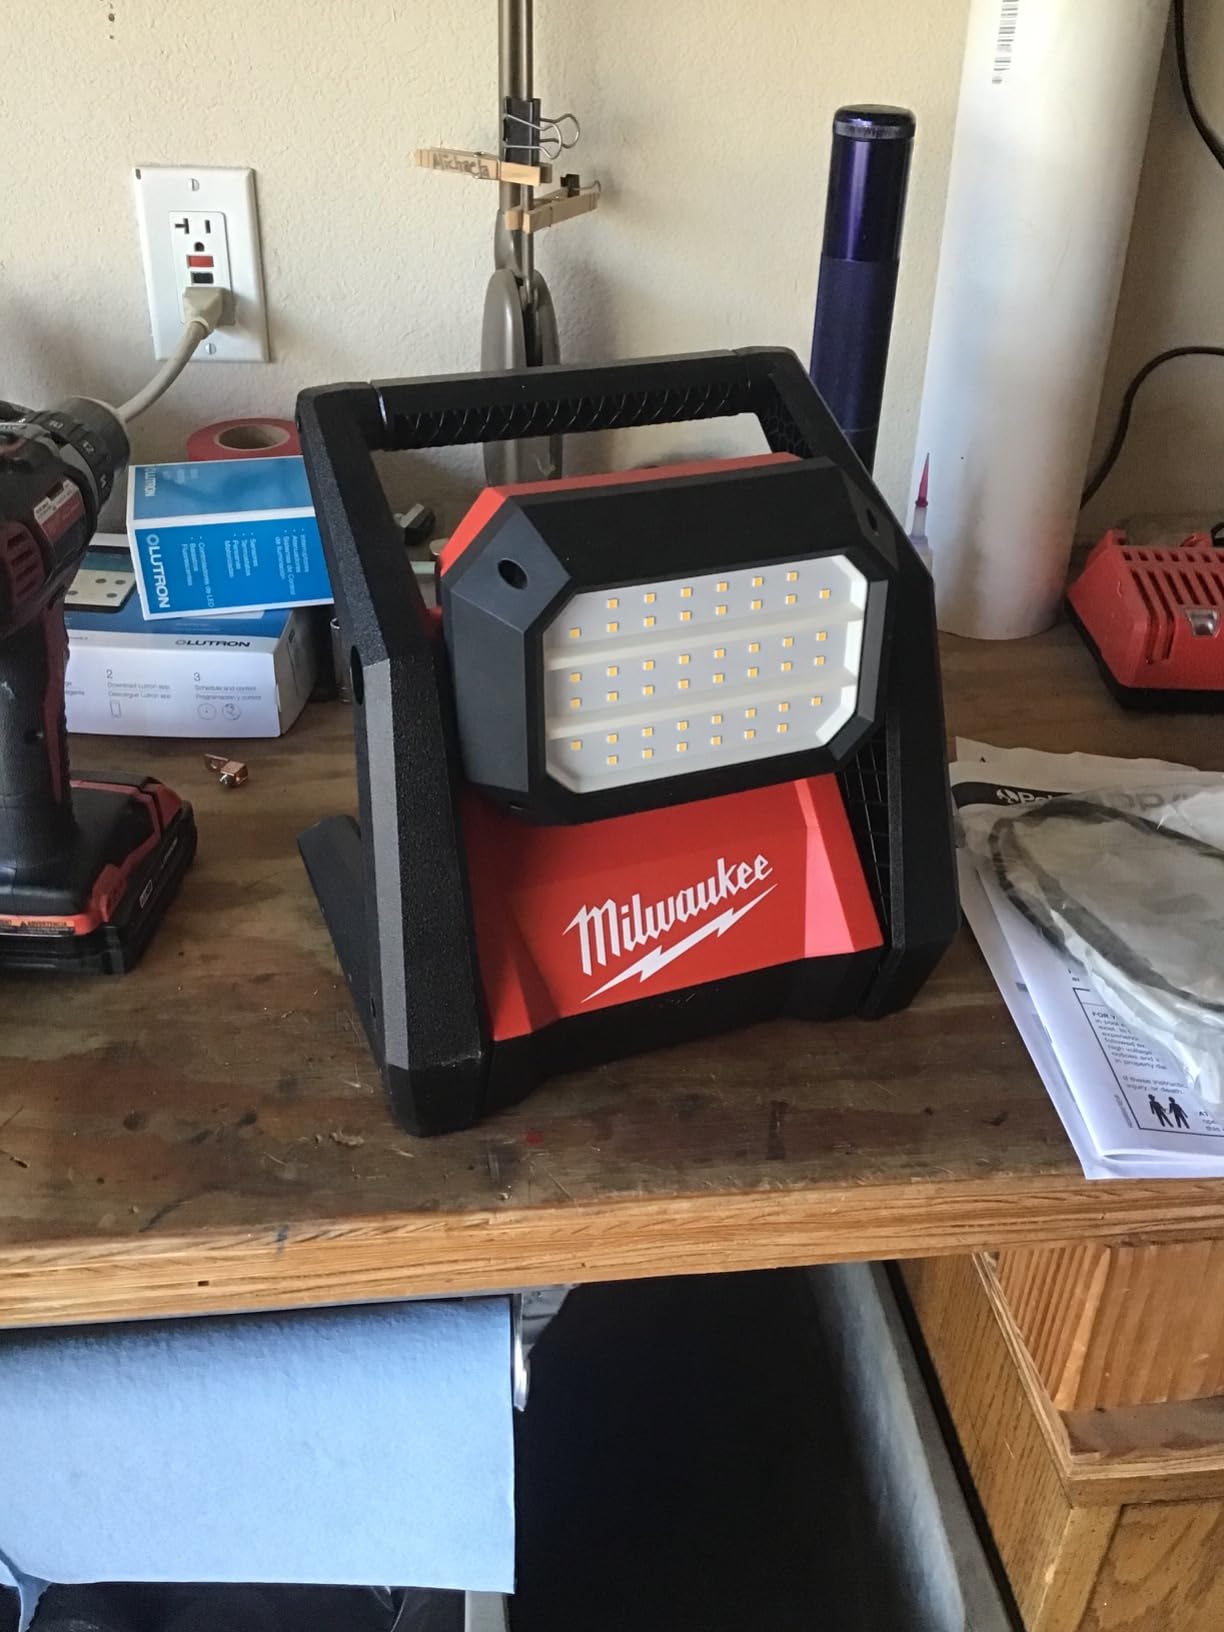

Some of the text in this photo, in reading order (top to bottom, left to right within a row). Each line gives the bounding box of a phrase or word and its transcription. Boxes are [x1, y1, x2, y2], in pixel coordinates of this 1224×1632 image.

[433, 153, 490, 178] Michaela
[148, 545, 171, 608] LUTRON
[206, 594, 215, 608] LED
[186, 640, 251, 648] LUTRON
[106, 669, 113, 679] 2
[193, 672, 201, 682] 3
[562, 854, 773, 976] Milwaukee
